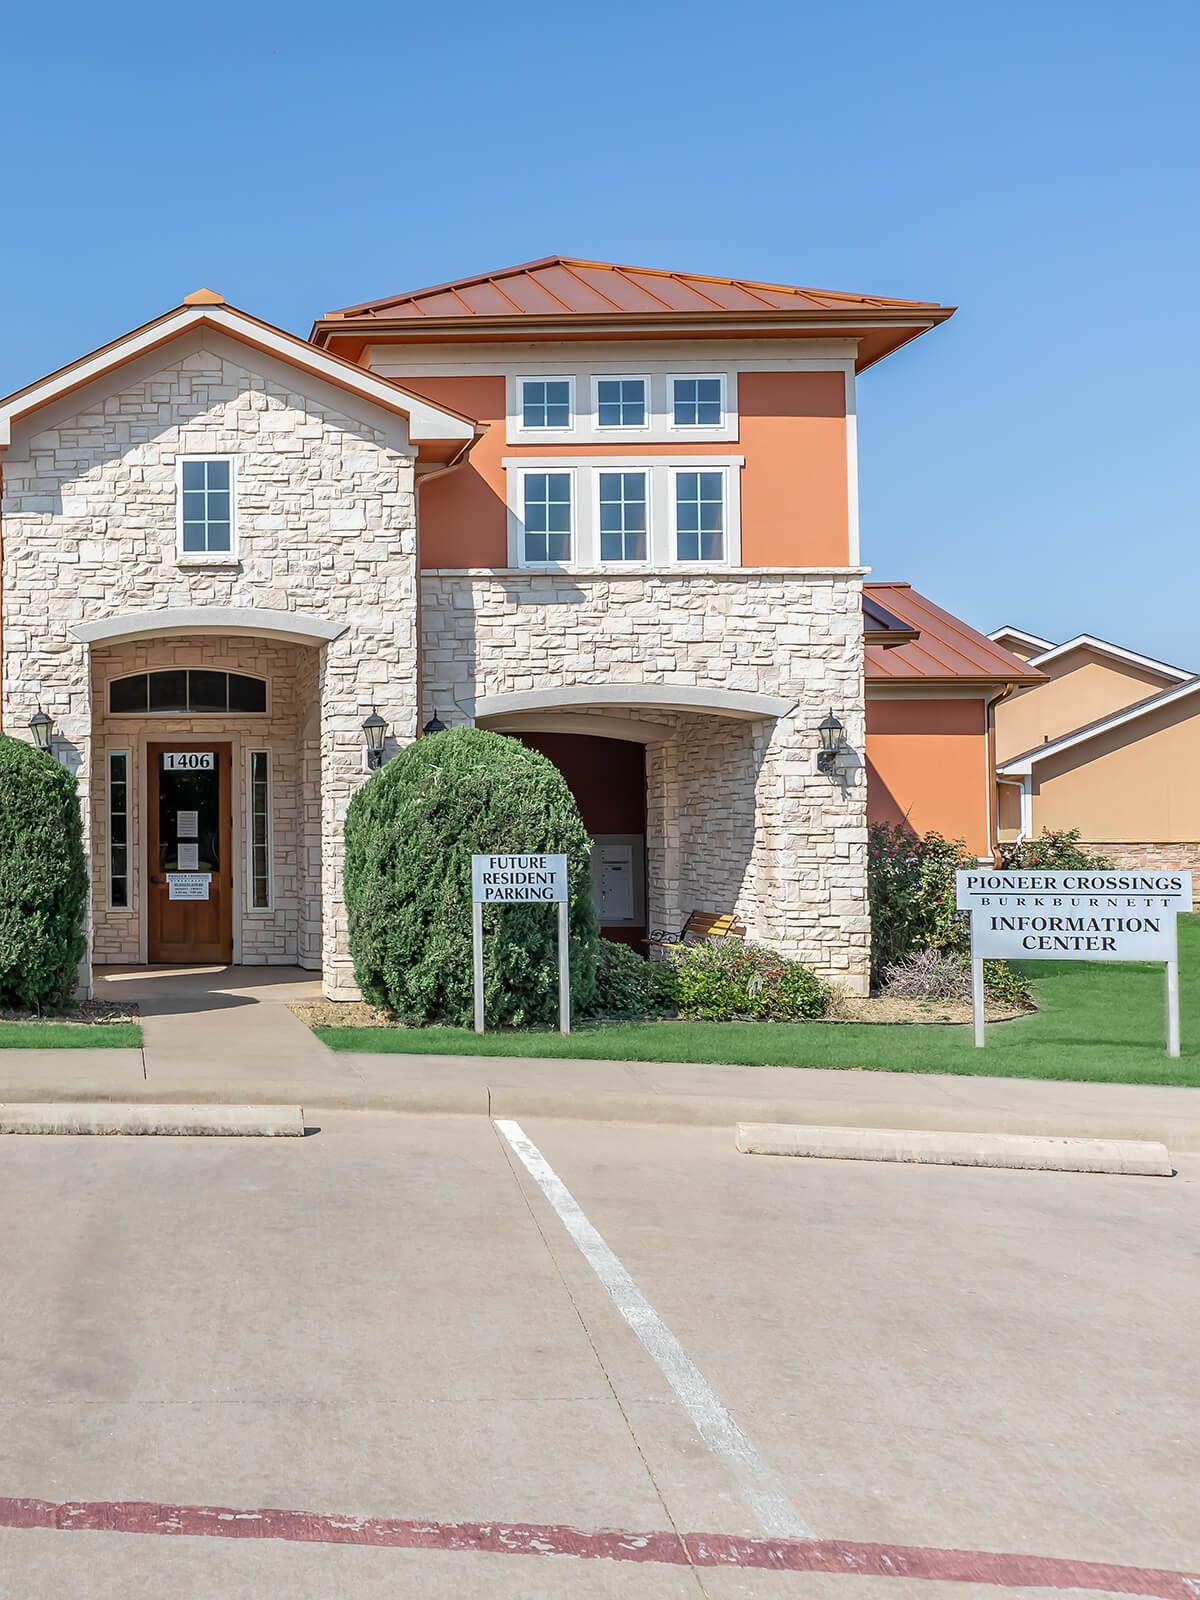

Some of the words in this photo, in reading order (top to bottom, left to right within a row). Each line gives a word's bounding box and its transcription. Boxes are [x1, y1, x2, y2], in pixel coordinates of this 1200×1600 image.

[167, 754, 210, 769] 1406
[490, 857, 547, 869] FUTURE
[483, 872, 557, 885] RESIDENT
[967, 876, 1058, 890] PIONEER
[1063, 876, 1183, 891] CROSSINGS
[485, 887, 554, 900] PARKING
[981, 897, 1171, 907] BURKBURNETT
[990, 916, 1161, 933] INFORMATION
[1022, 935, 1117, 951] CENTER
